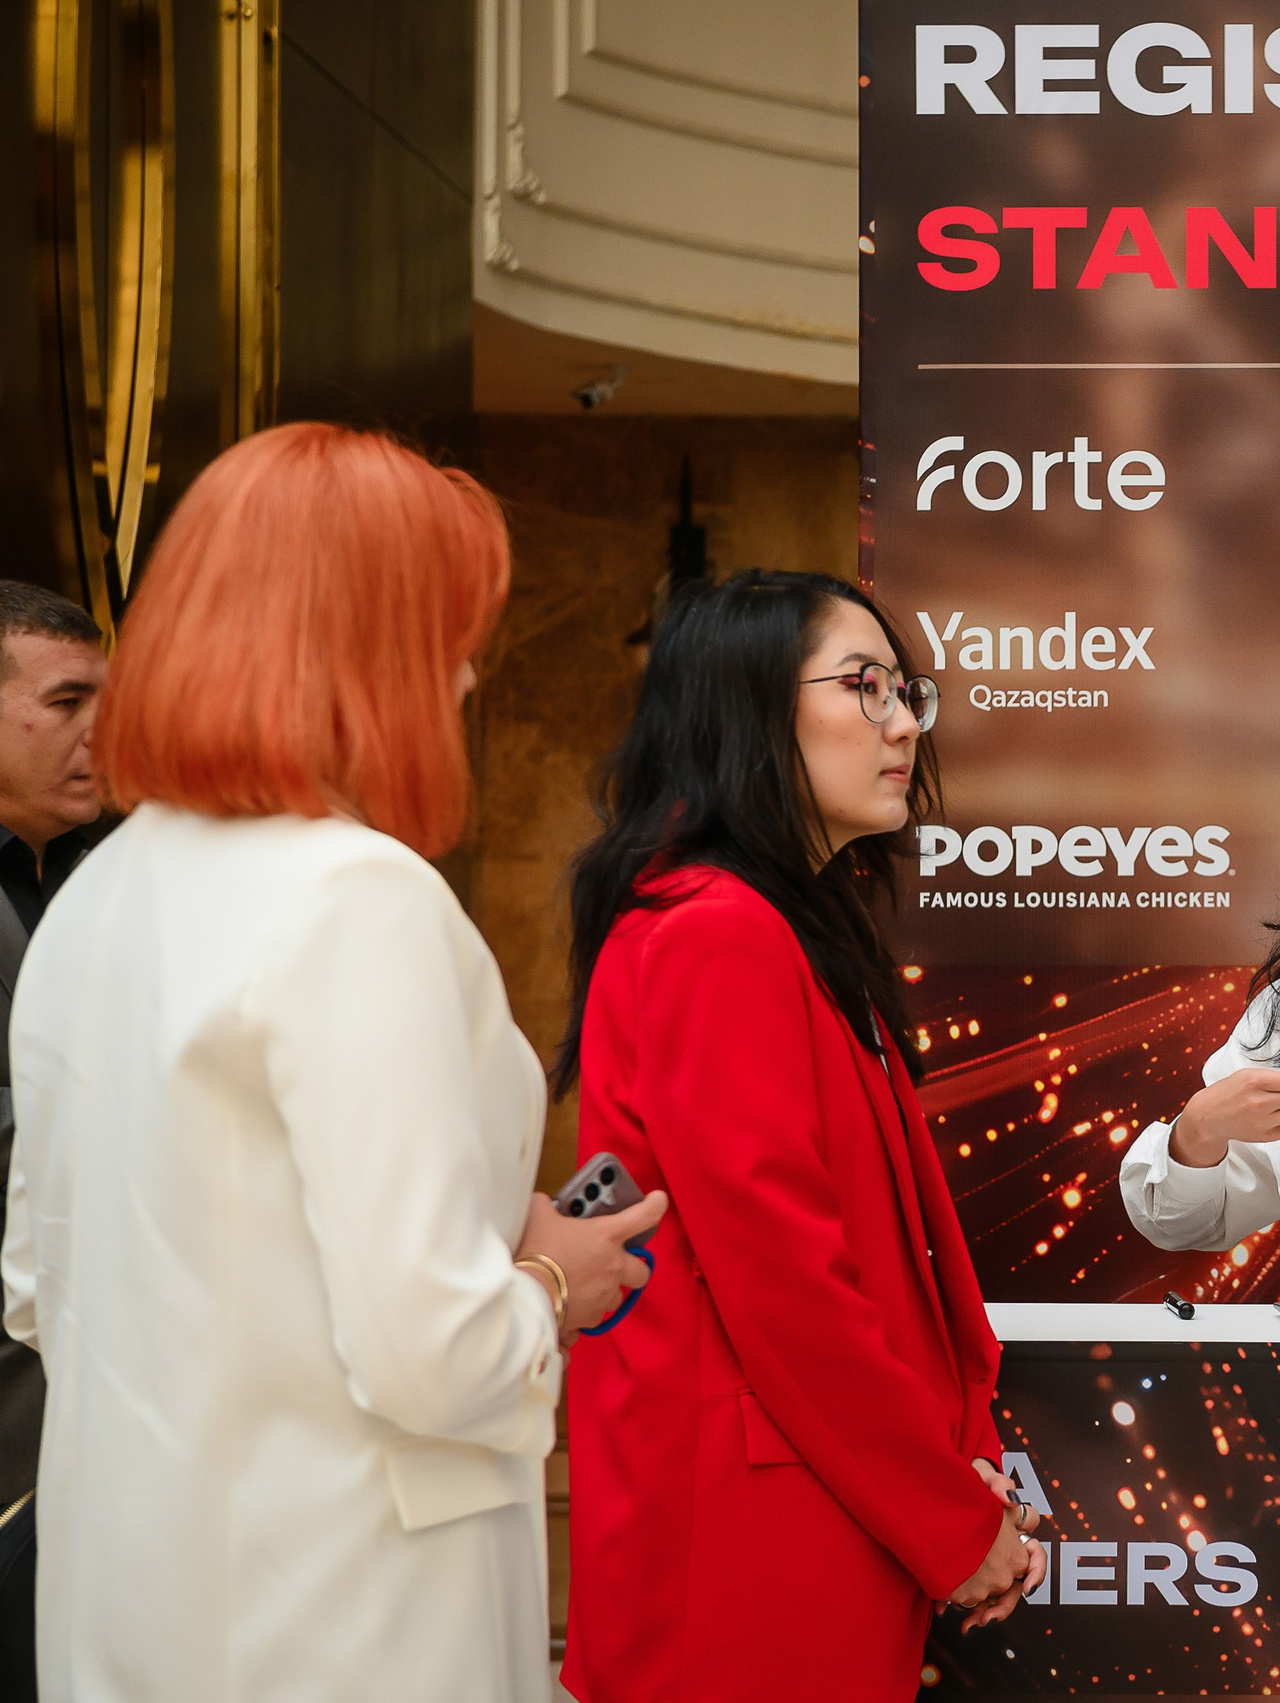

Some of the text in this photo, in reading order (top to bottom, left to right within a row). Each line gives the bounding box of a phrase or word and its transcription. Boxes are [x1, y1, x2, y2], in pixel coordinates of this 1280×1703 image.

[916, 611, 1156, 671] Yandex
[969, 684, 1109, 712] Qazaqstan
[919, 892, 1230, 908] FAMOUS LOUISIANA CHICKEN
